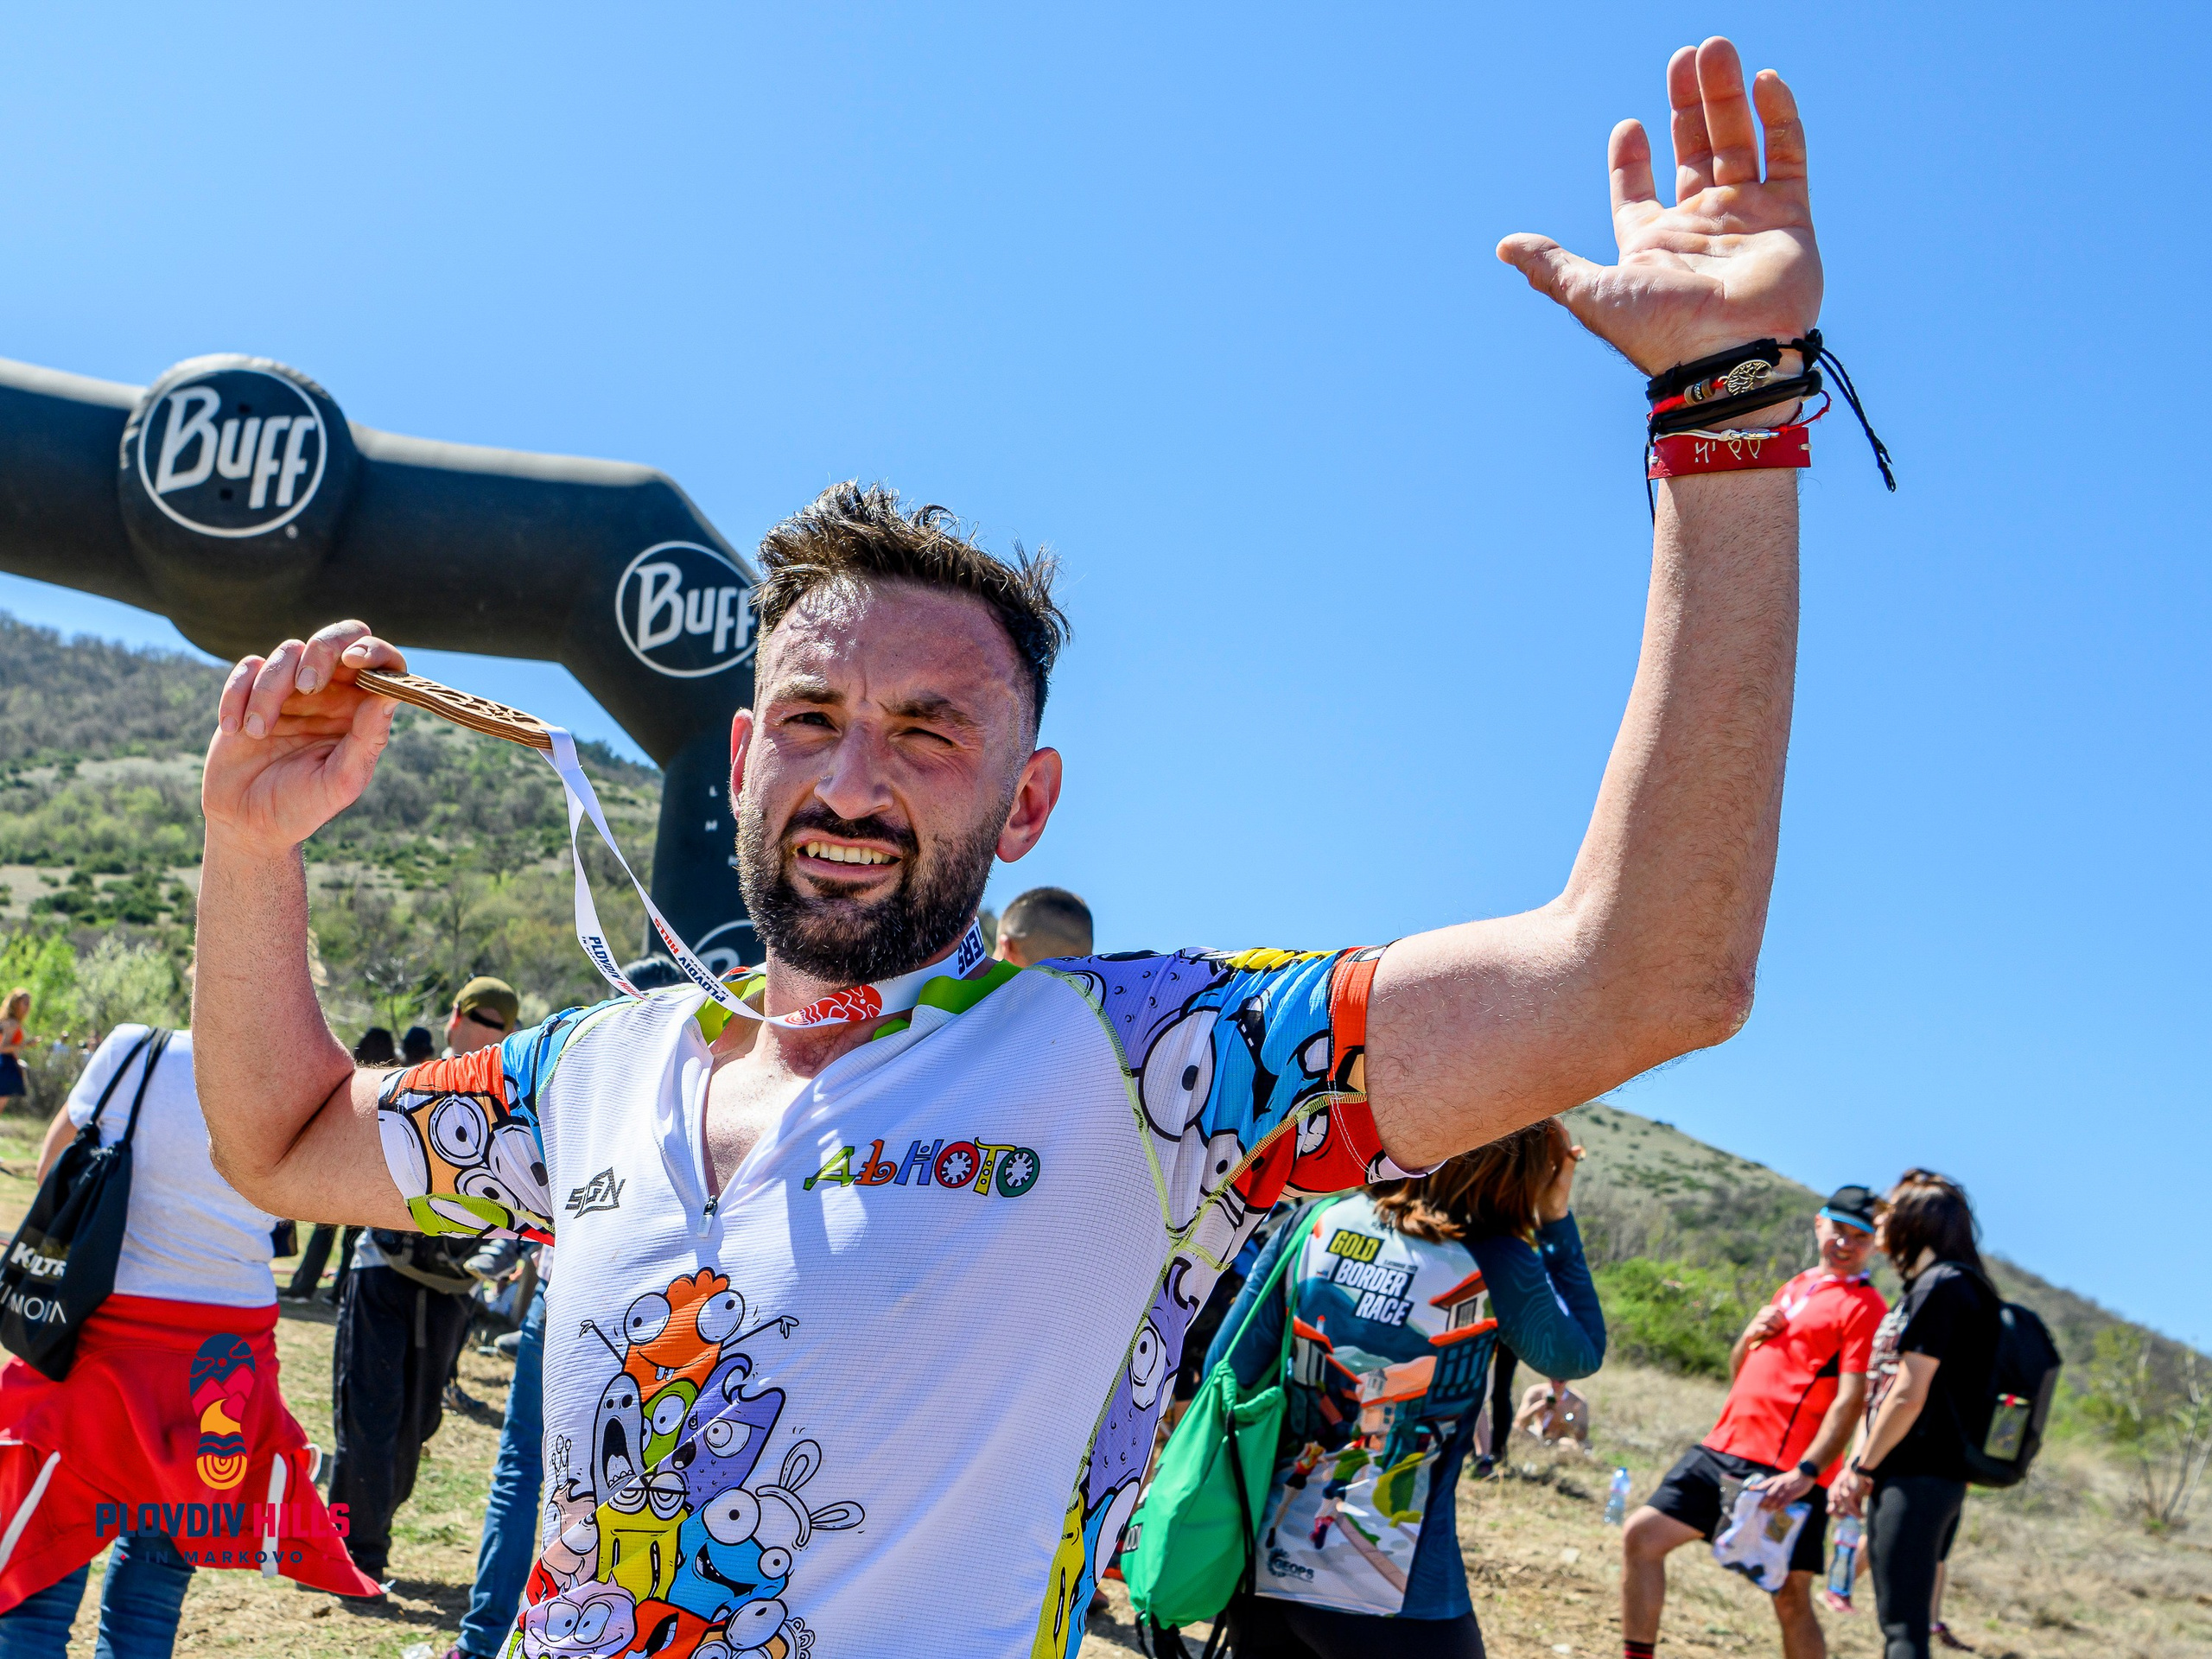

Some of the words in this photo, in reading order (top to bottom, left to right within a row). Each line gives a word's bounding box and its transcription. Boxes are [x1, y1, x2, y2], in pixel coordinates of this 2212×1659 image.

[654, 918, 679, 954] HILLS
[678, 957, 727, 1002] PLOVDIV
[1329, 1230, 1380, 1262] GOLD
[1334, 1258, 1408, 1297] BORDER
[1355, 1291, 1411, 1326] RACE
